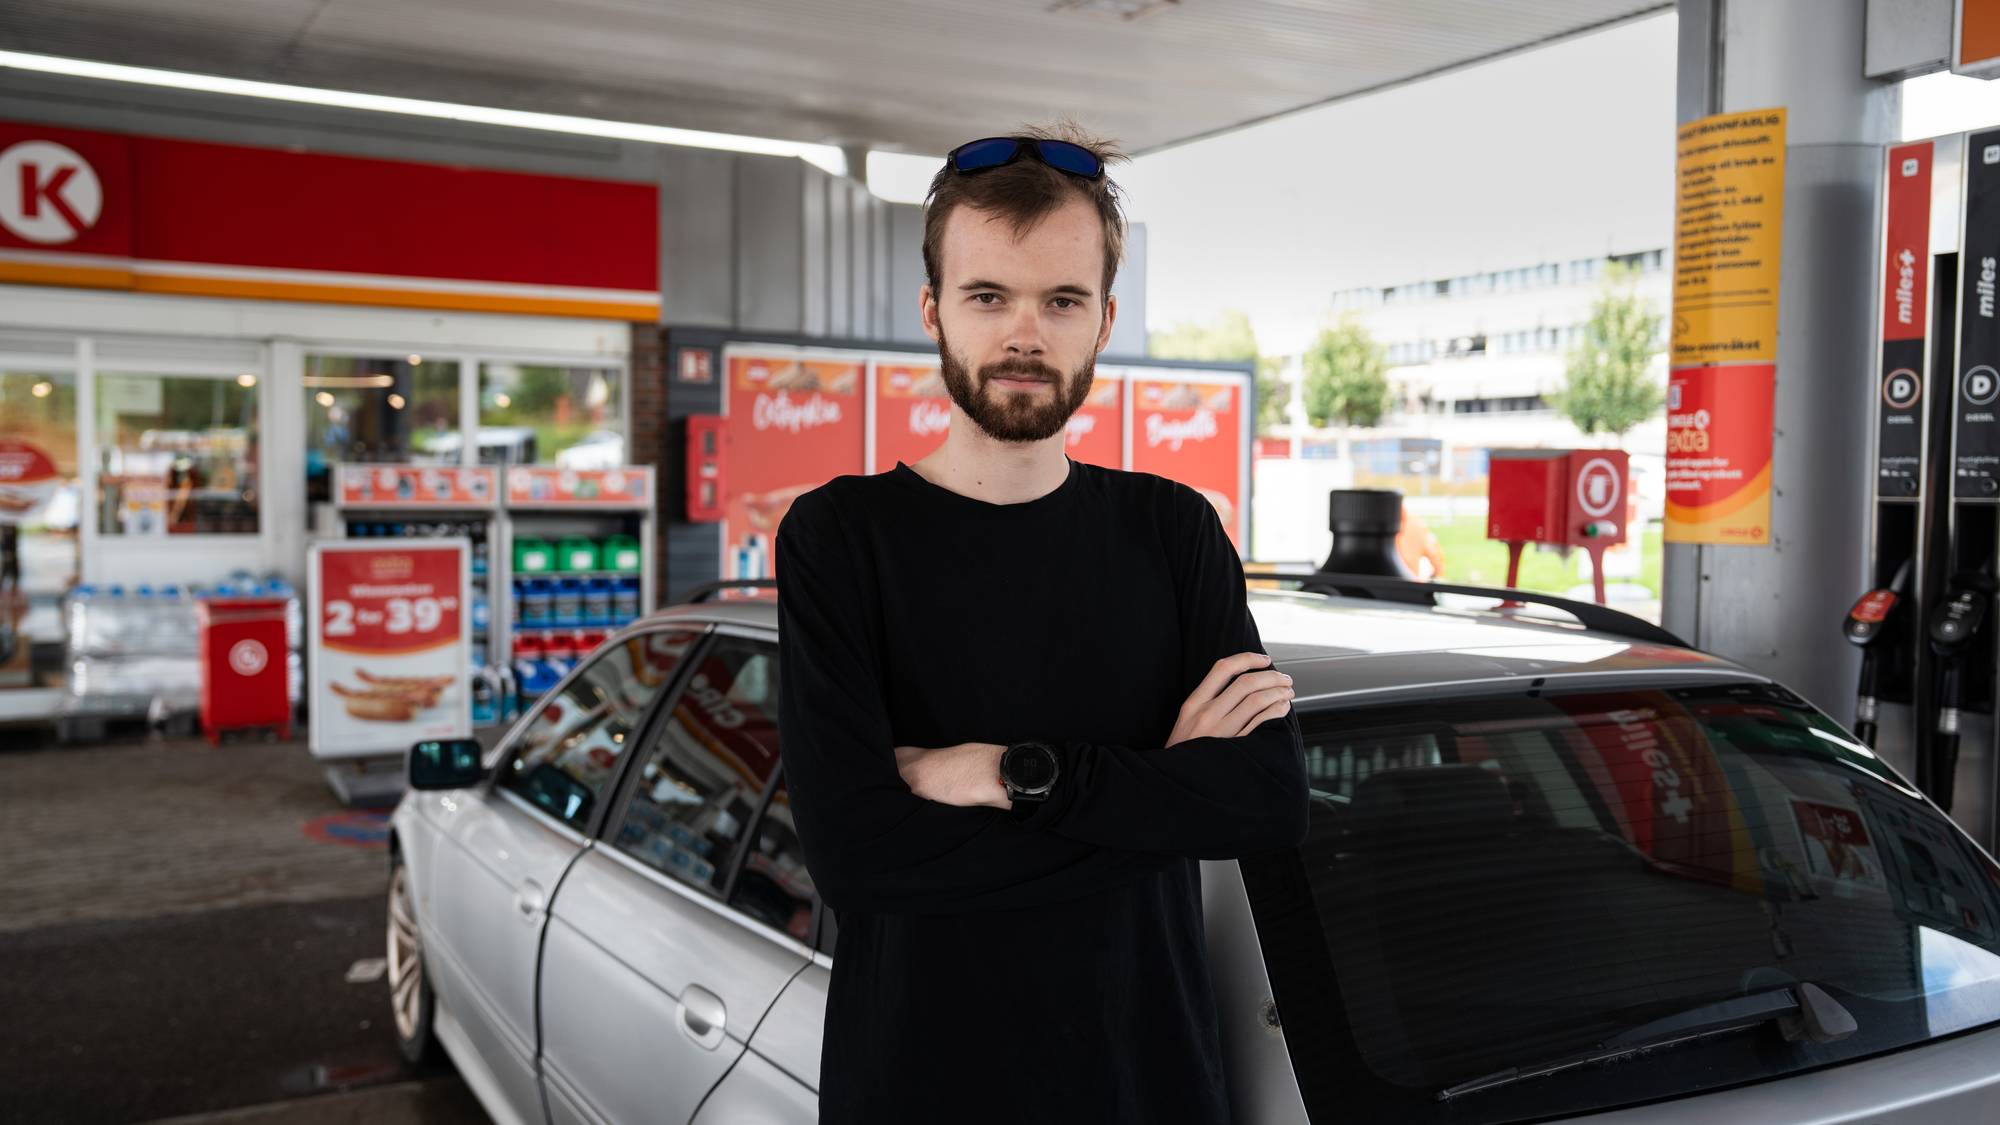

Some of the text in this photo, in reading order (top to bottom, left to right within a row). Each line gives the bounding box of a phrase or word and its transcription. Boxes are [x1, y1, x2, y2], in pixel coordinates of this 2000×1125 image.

[1896, 249, 1915, 324] miles+
[1976, 256, 1996, 317] miles
[1893, 379, 1910, 398] D
[1972, 375, 1991, 395] D
[325, 601, 355, 636] 2
[386, 597, 441, 634] 39
